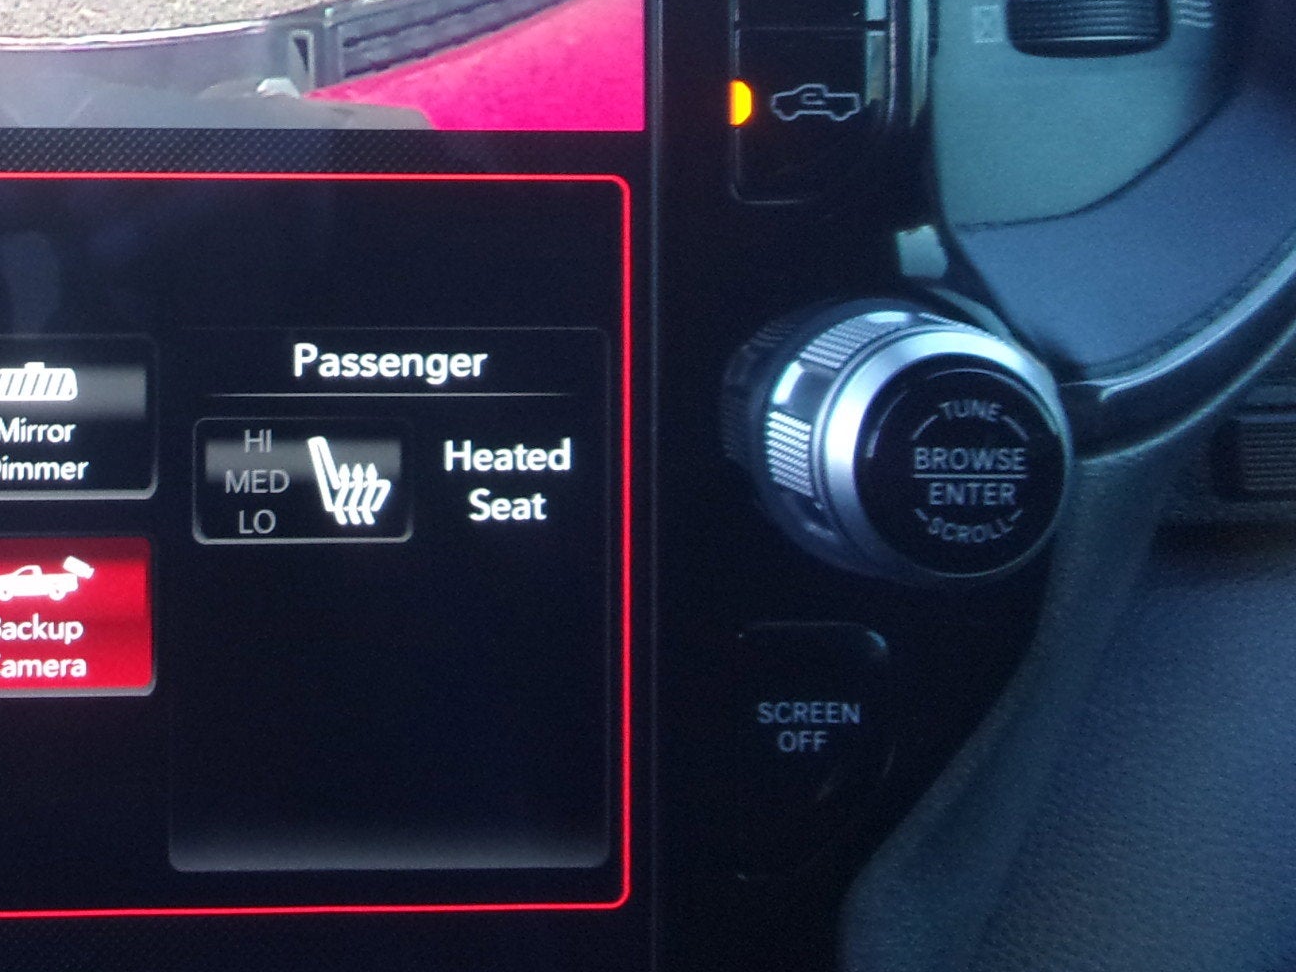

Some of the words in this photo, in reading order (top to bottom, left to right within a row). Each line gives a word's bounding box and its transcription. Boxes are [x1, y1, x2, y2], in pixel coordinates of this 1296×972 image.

[292, 343, 489, 386] Passenger
[939, 399, 1003, 422] TUNE
[243, 429, 273, 455] HI
[443, 437, 572, 473] Heated
[913, 447, 1028, 471] BROWSE
[224, 468, 290, 496] MED
[929, 483, 1017, 507] ENTER
[468, 487, 547, 523] Seat
[238, 509, 277, 536] LO
[928, 516, 1011, 543] SCROLL
[757, 702, 862, 726] SCREEN
[777, 730, 828, 753] OFF
